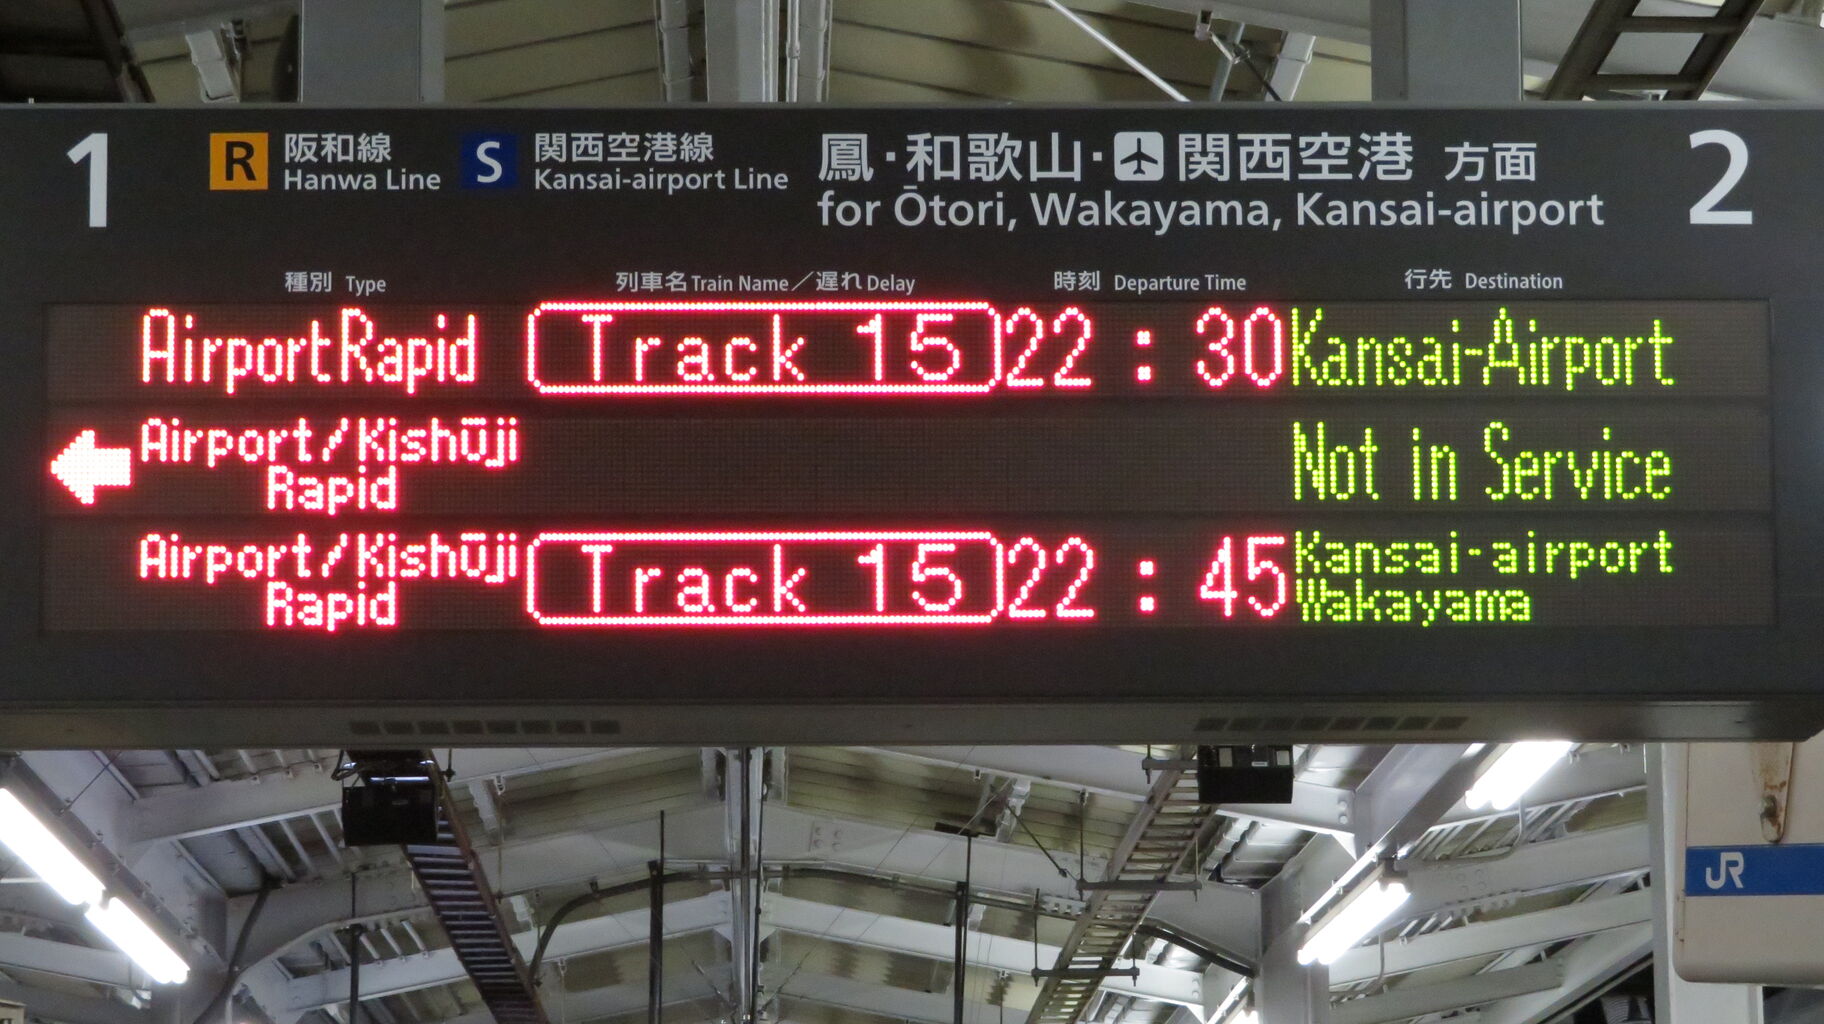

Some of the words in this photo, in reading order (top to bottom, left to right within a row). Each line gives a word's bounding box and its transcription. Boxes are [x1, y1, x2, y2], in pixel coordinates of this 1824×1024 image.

[225, 141, 256, 181] R
[285, 133, 391, 163] 阪和線
[477, 142, 502, 182] S
[535, 133, 713, 162] 関西空港線
[1445, 142, 1537, 182] 方面
[68, 133, 107, 227] 1
[285, 169, 377, 190] Hanwa
[387, 168, 441, 190] Line
[535, 167, 725, 195] Kansai-airport
[735, 168, 789, 190] Line
[1689, 129, 1753, 225] 2
[818, 189, 881, 227] for
[895, 186, 1016, 232] Ōtori,
[1031, 190, 1281, 236] Wakayama,
[1297, 190, 1605, 235] Kansai-airport
[284, 271, 332, 293] 種別
[346, 275, 386, 297] Type
[616, 271, 687, 293] 列車名
[691, 275, 732, 292] Train
[868, 273, 916, 296] Delay
[1054, 270, 1100, 292] 時刻
[1115, 274, 1200, 296] Departure
[1205, 274, 1247, 291] Time
[1404, 268, 1452, 290] 行先
[1465, 272, 1563, 290] Destination
[581, 313, 805, 382] Track
[856, 313, 961, 381] 15
[1292, 307, 1675, 392] Kansai-Airport
[1292, 421, 1380, 501] Not
[1412, 427, 1457, 501] in
[1483, 421, 1672, 501] Service
[267, 464, 397, 516] Rapid
[1294, 529, 1674, 580] Kansai-airport
[580, 543, 806, 613] Track
[857, 542, 963, 612] 15
[266, 580, 396, 635] Rapid
[1295, 577, 1532, 628] Wakayama
[1705, 852, 1744, 889] JR
